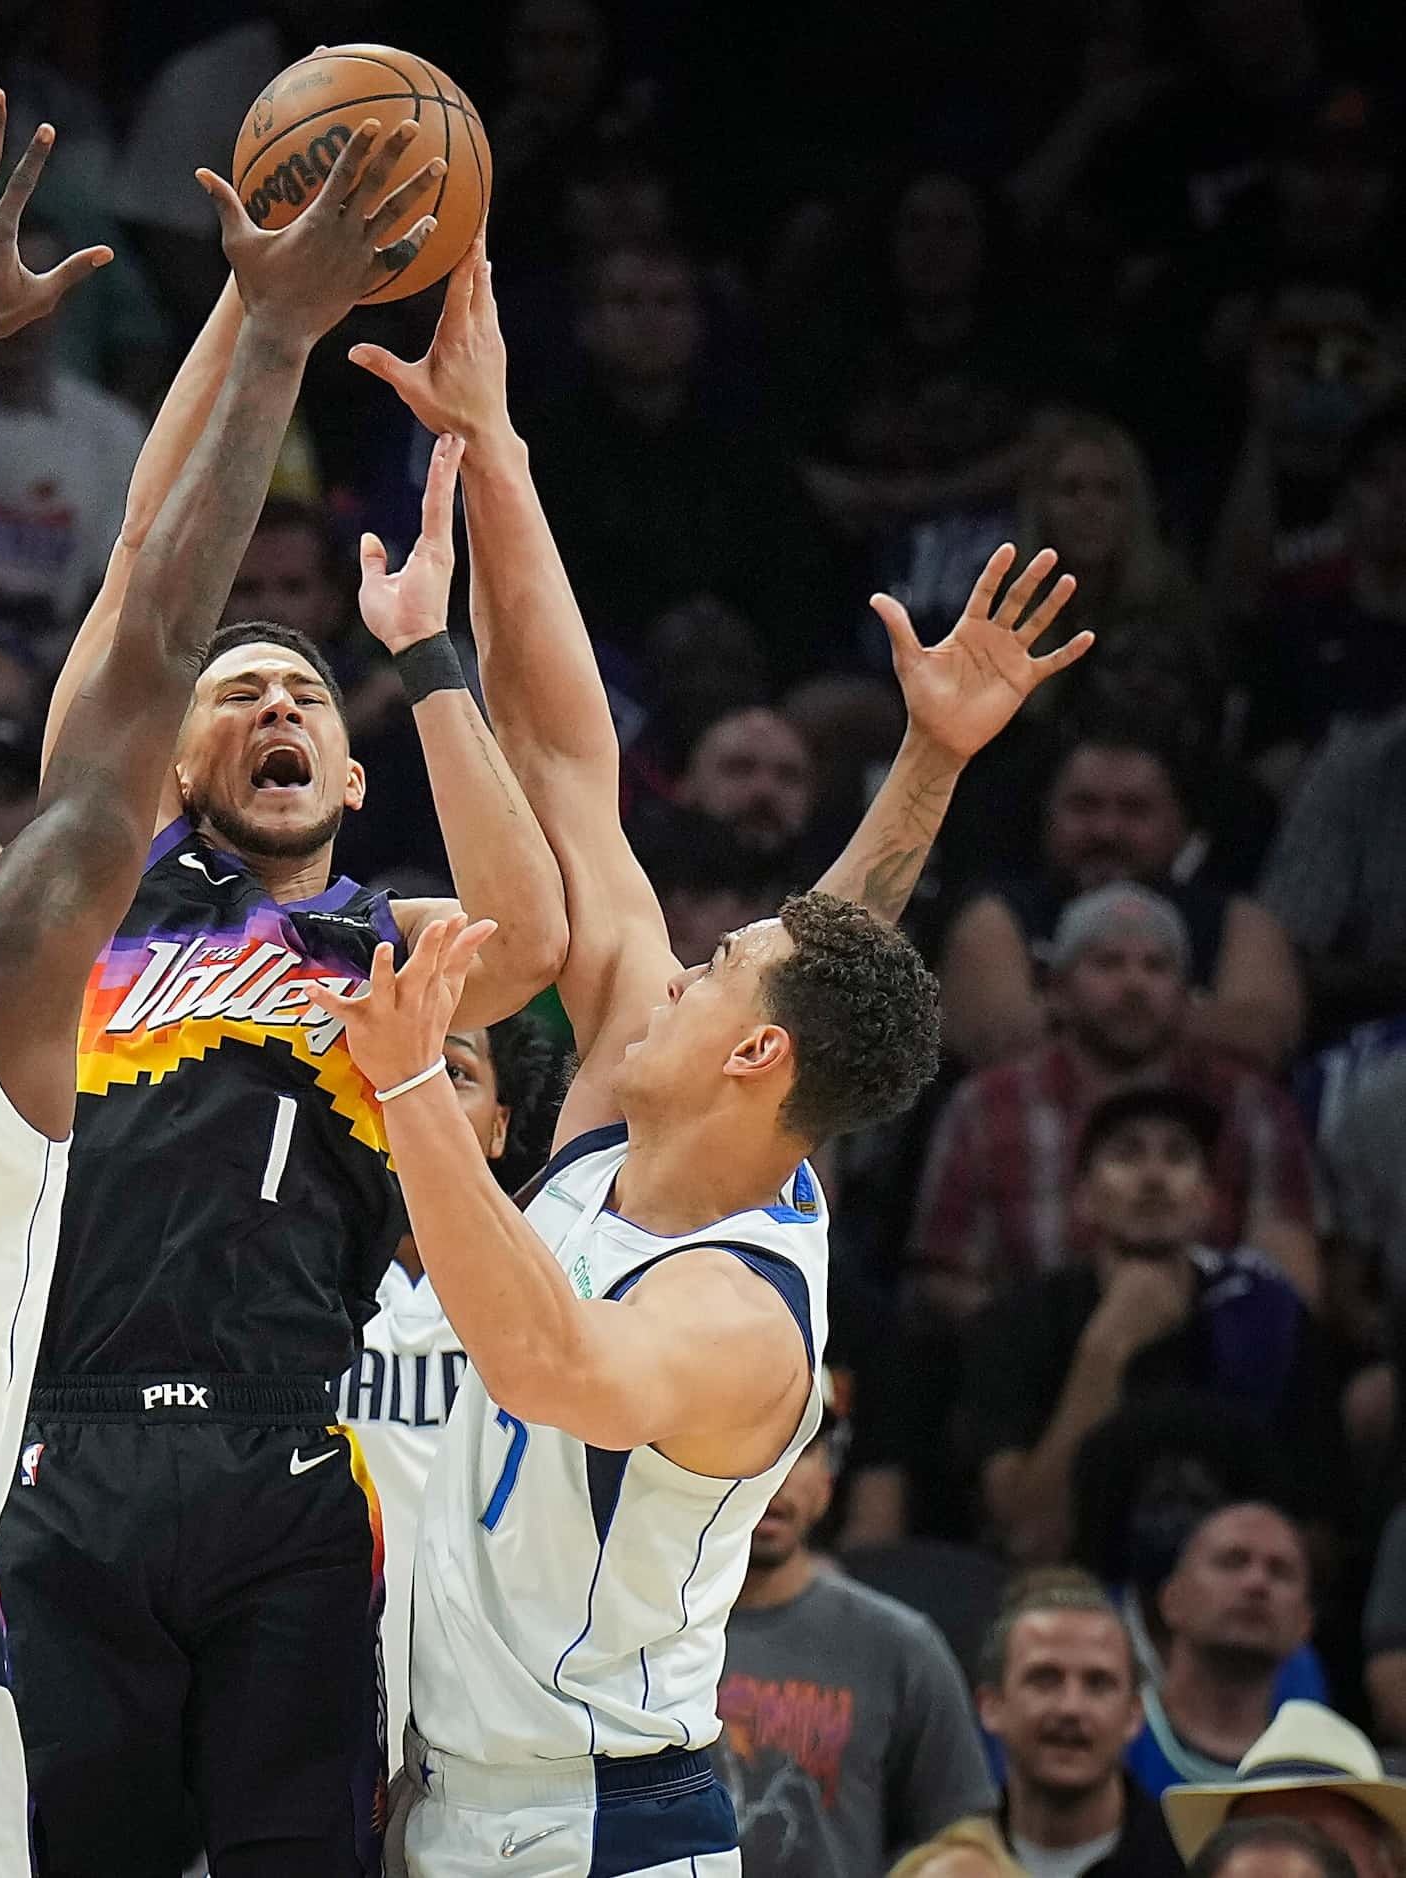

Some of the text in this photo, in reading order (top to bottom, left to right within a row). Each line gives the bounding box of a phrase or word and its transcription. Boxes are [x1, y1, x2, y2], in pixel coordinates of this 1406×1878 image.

[104, 936, 372, 1056] Valley
[200, 943, 251, 963] THE
[261, 1095, 298, 1203] 1
[141, 1383, 210, 1411] PHX
[477, 1407, 531, 1536] 7
